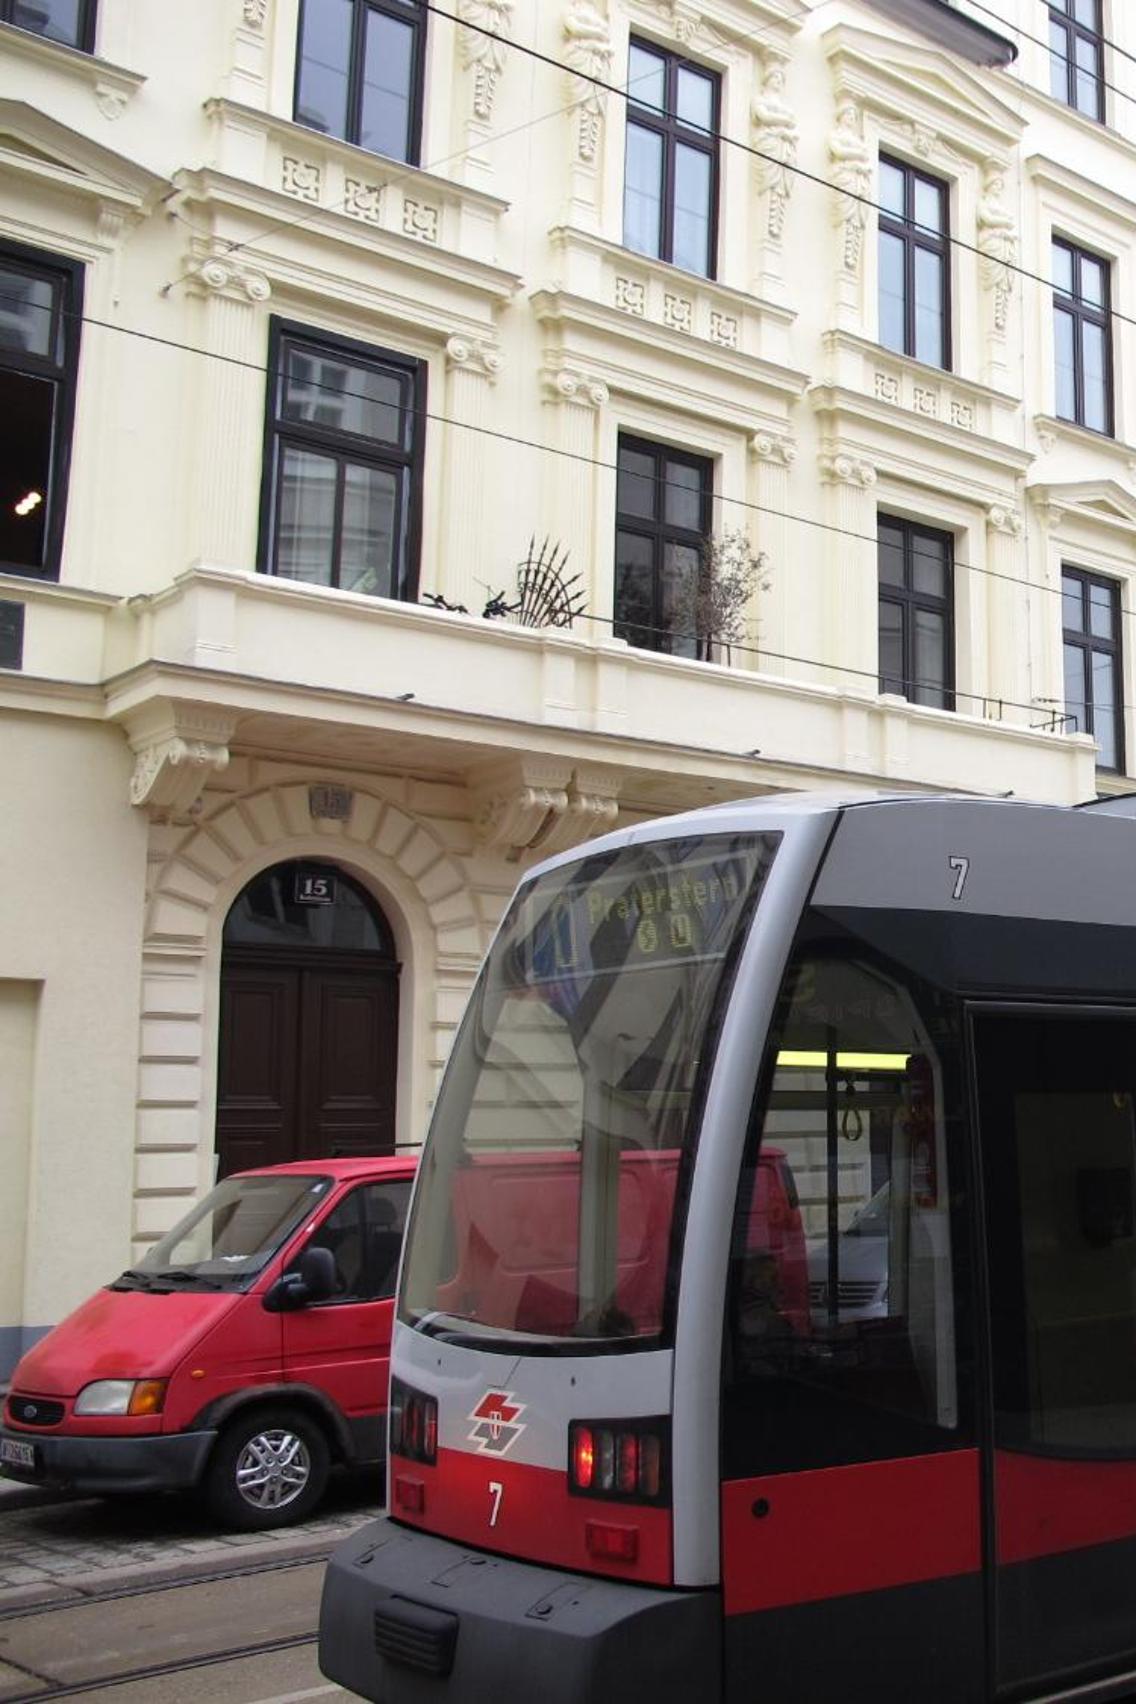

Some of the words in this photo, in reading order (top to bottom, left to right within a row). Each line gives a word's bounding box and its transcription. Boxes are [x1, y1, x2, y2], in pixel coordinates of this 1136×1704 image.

[304, 879, 328, 896] 15
[948, 855, 969, 900] 7
[488, 1481, 503, 1527] 7
